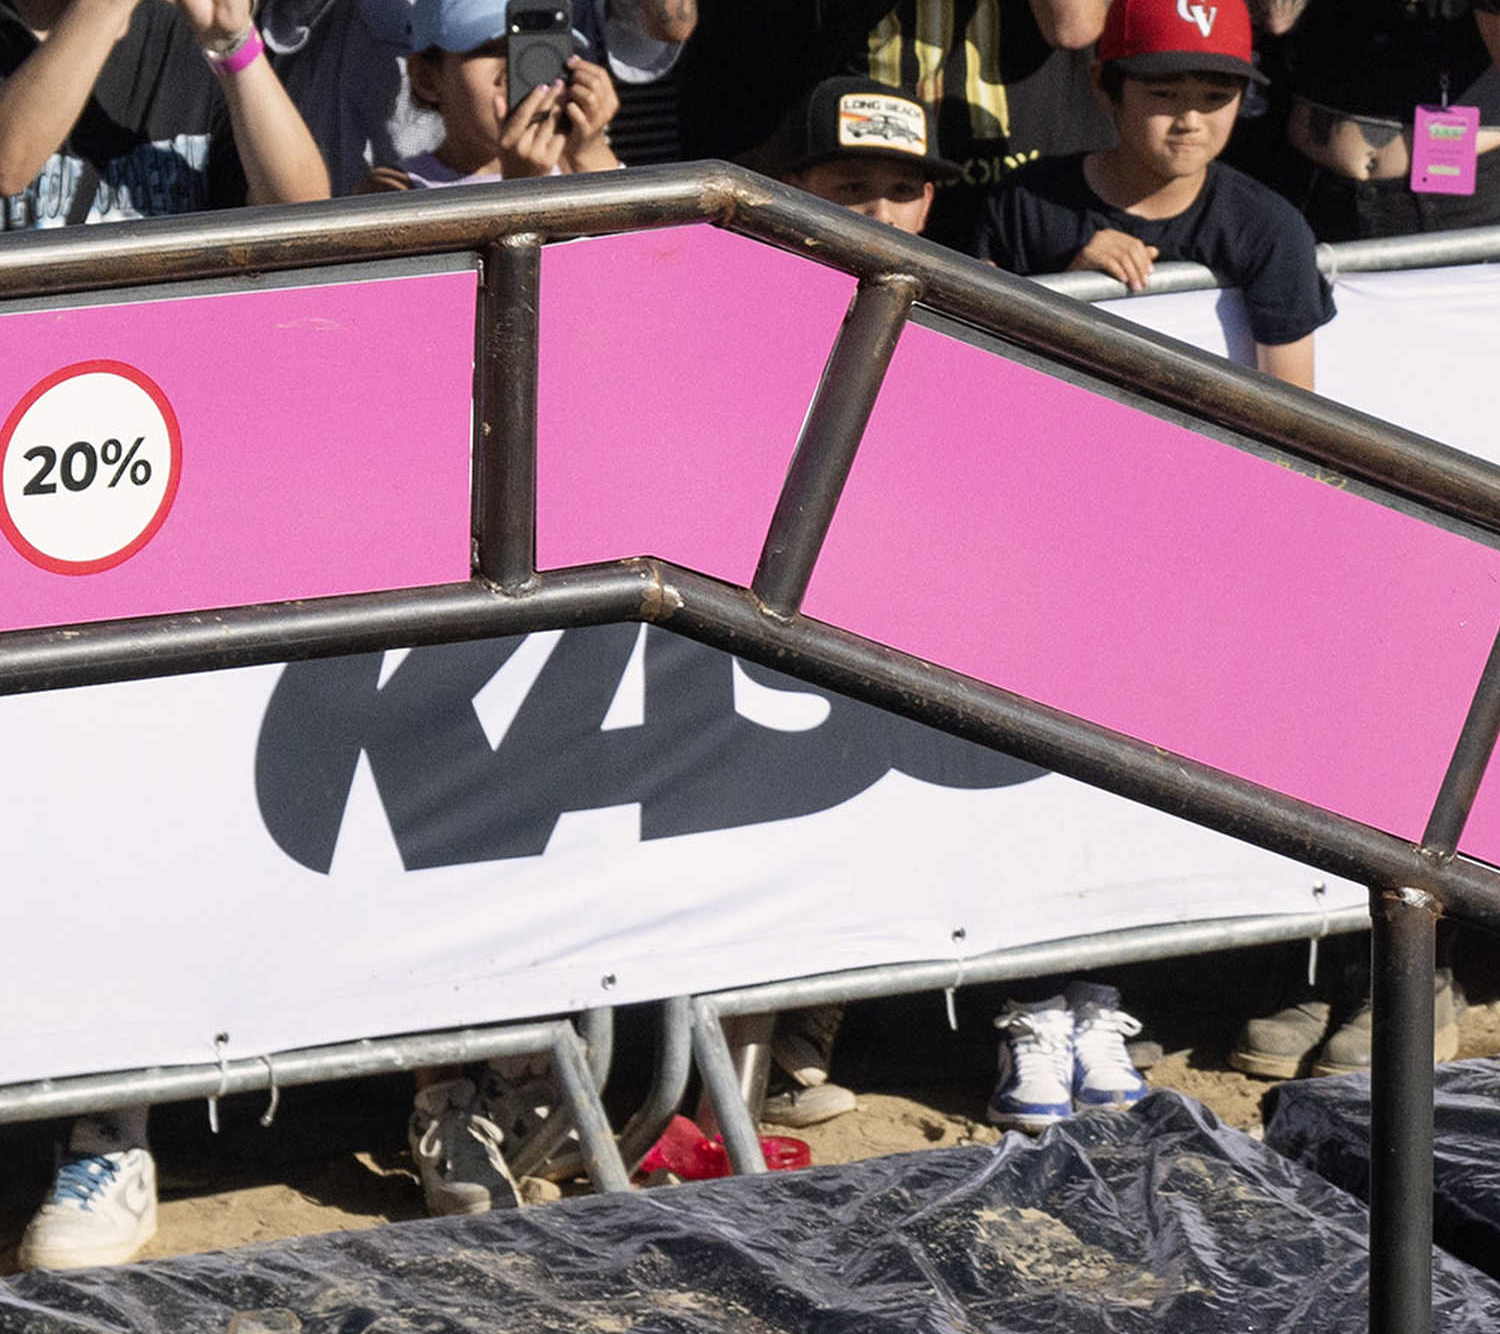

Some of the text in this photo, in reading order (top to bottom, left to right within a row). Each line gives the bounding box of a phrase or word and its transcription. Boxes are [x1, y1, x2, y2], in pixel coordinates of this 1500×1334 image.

[842, 97, 921, 119] LONG BEACH
[22, 436, 152, 497] 20%
